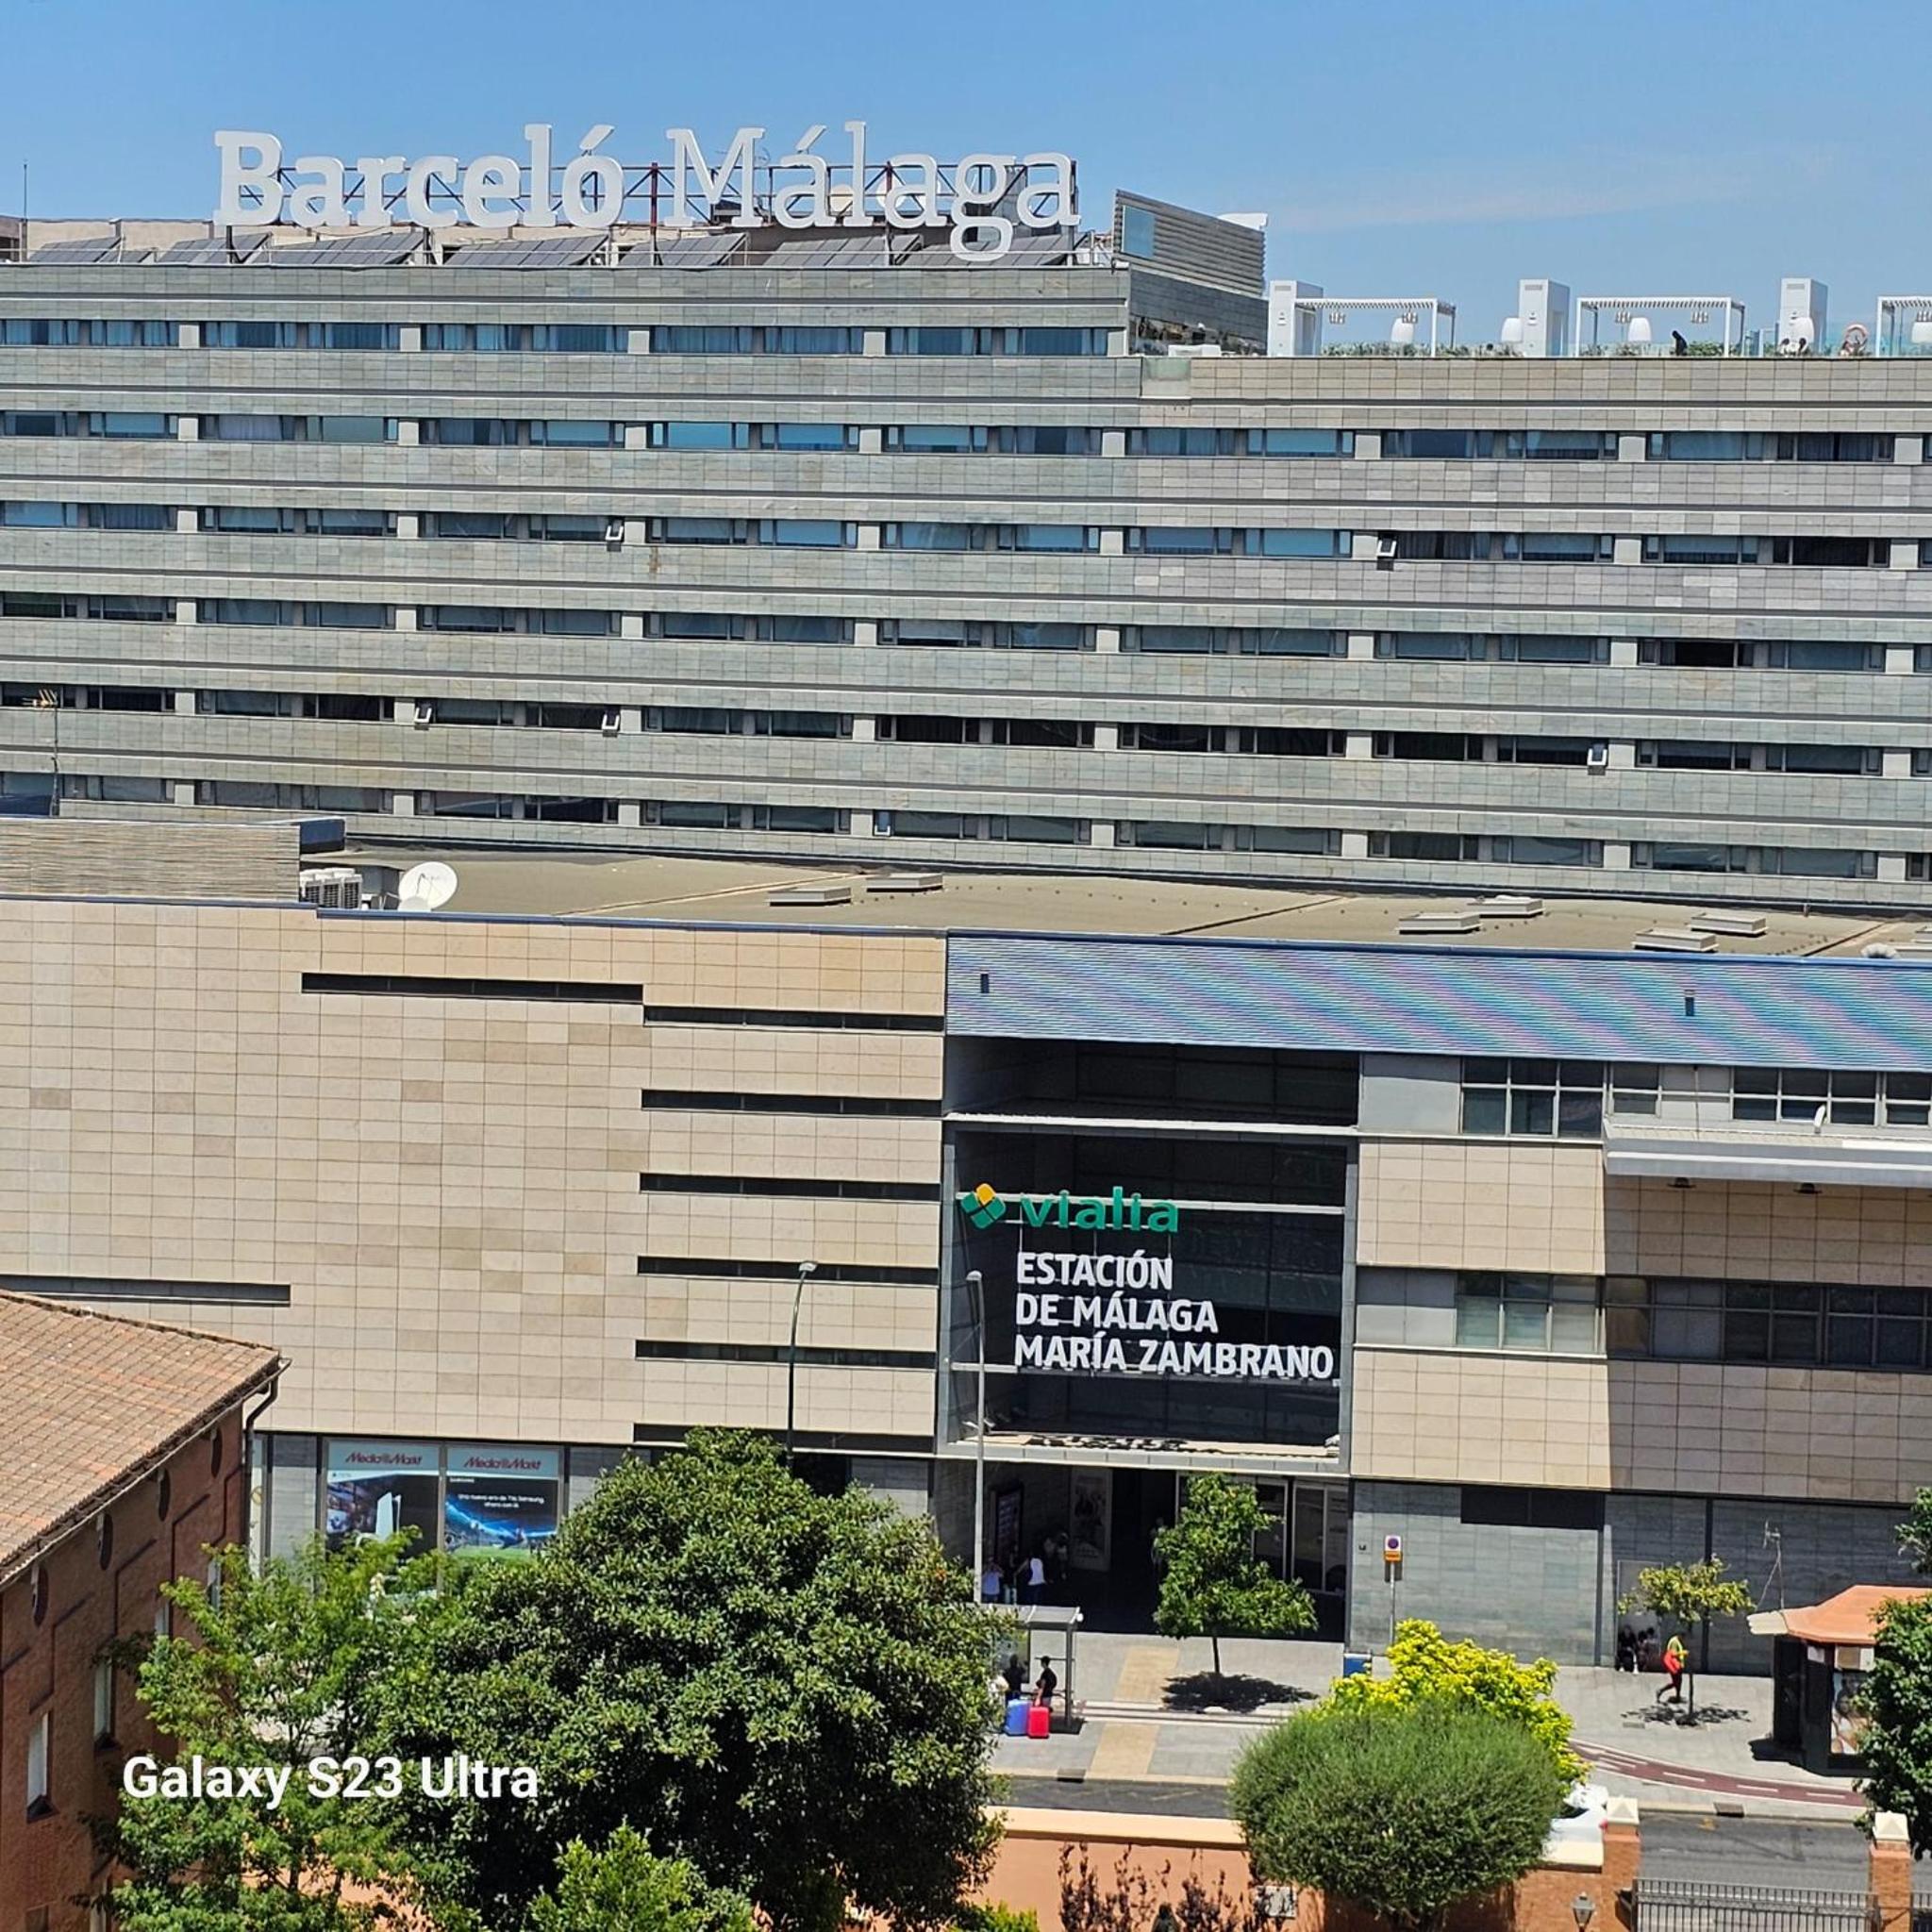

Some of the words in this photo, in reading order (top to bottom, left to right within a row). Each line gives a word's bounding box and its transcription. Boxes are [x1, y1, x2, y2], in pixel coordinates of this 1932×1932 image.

[212, 123, 625, 228] Barceló
[664, 121, 1081, 262] Málaga
[1020, 1186, 1178, 1233] vialia
[1017, 1250, 1173, 1291] ESTACIÓN
[1016, 1292, 1058, 1326] DE
[1073, 1291, 1219, 1334] MÁLAGA
[1014, 1331, 1126, 1370] MARÍA
[1139, 1340, 1333, 1379] ZAMBRANO
